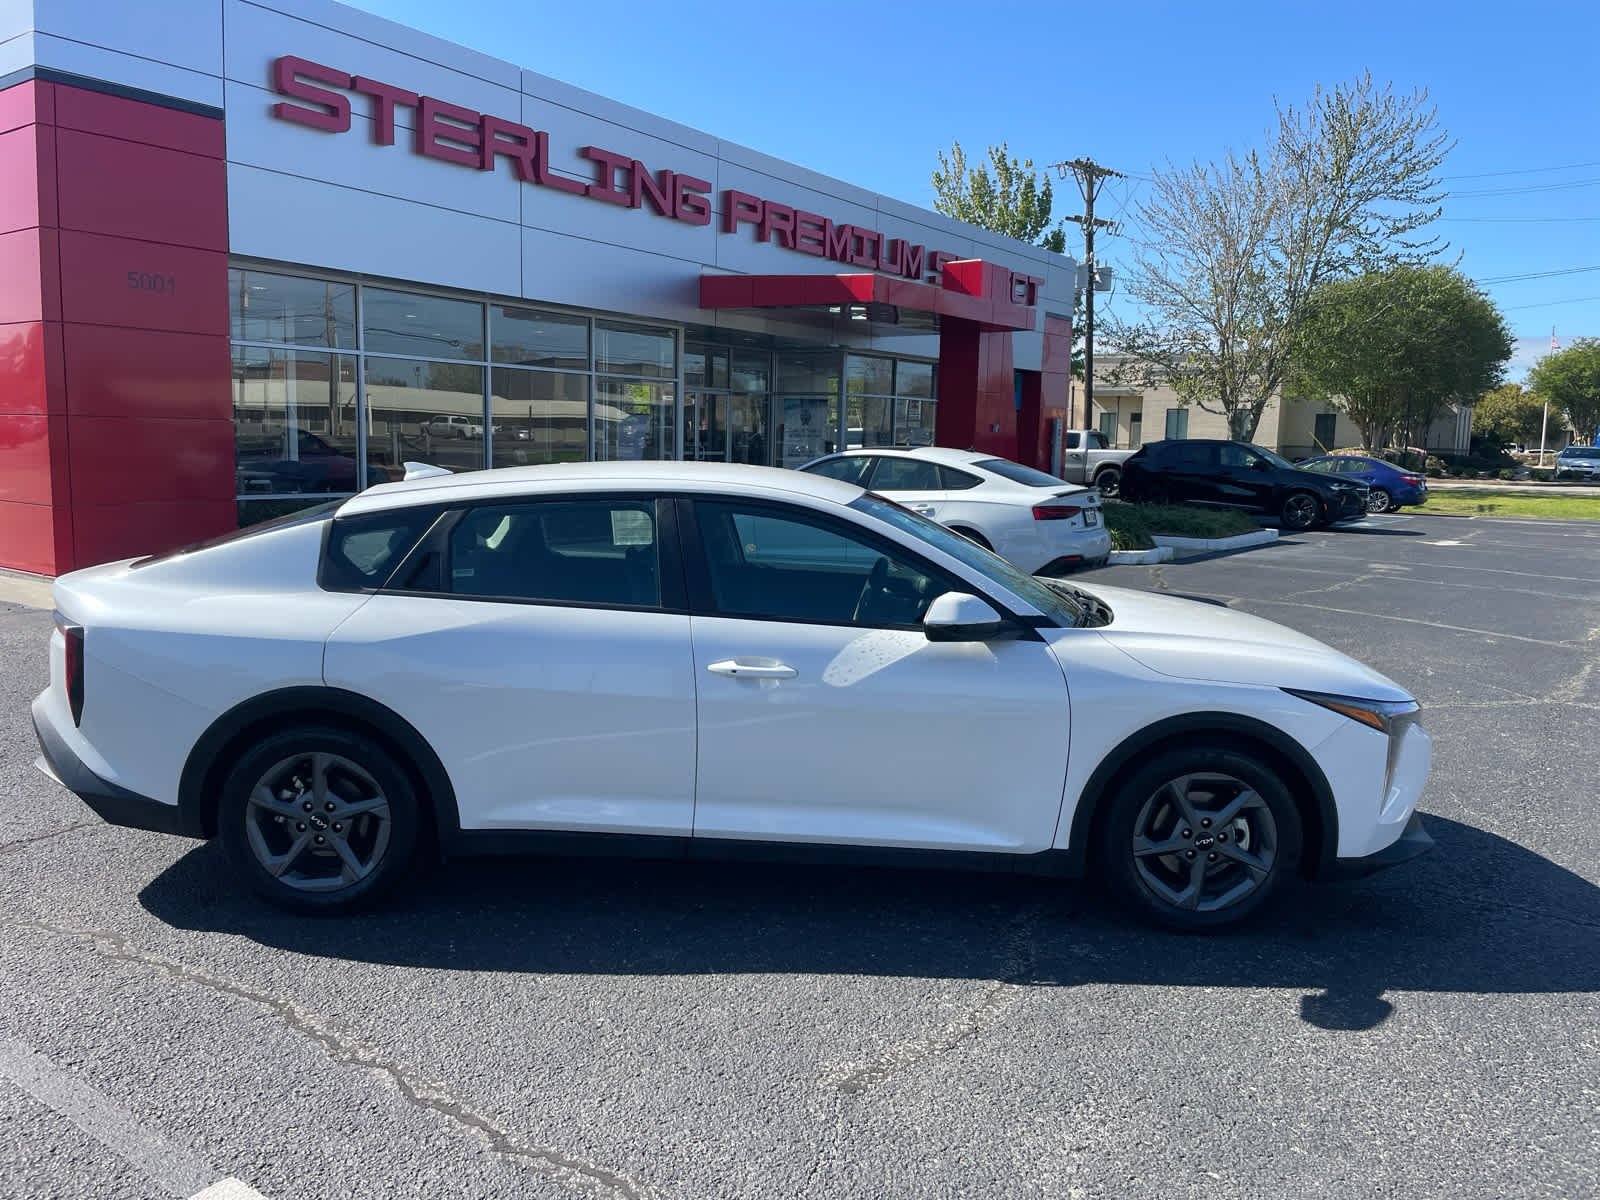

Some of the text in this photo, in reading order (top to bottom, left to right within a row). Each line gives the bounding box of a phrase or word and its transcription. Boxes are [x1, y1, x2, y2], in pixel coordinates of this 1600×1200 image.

[273, 55, 1045, 306] STERLING PREMIUM SCT
[127, 271, 176, 296] 5001
